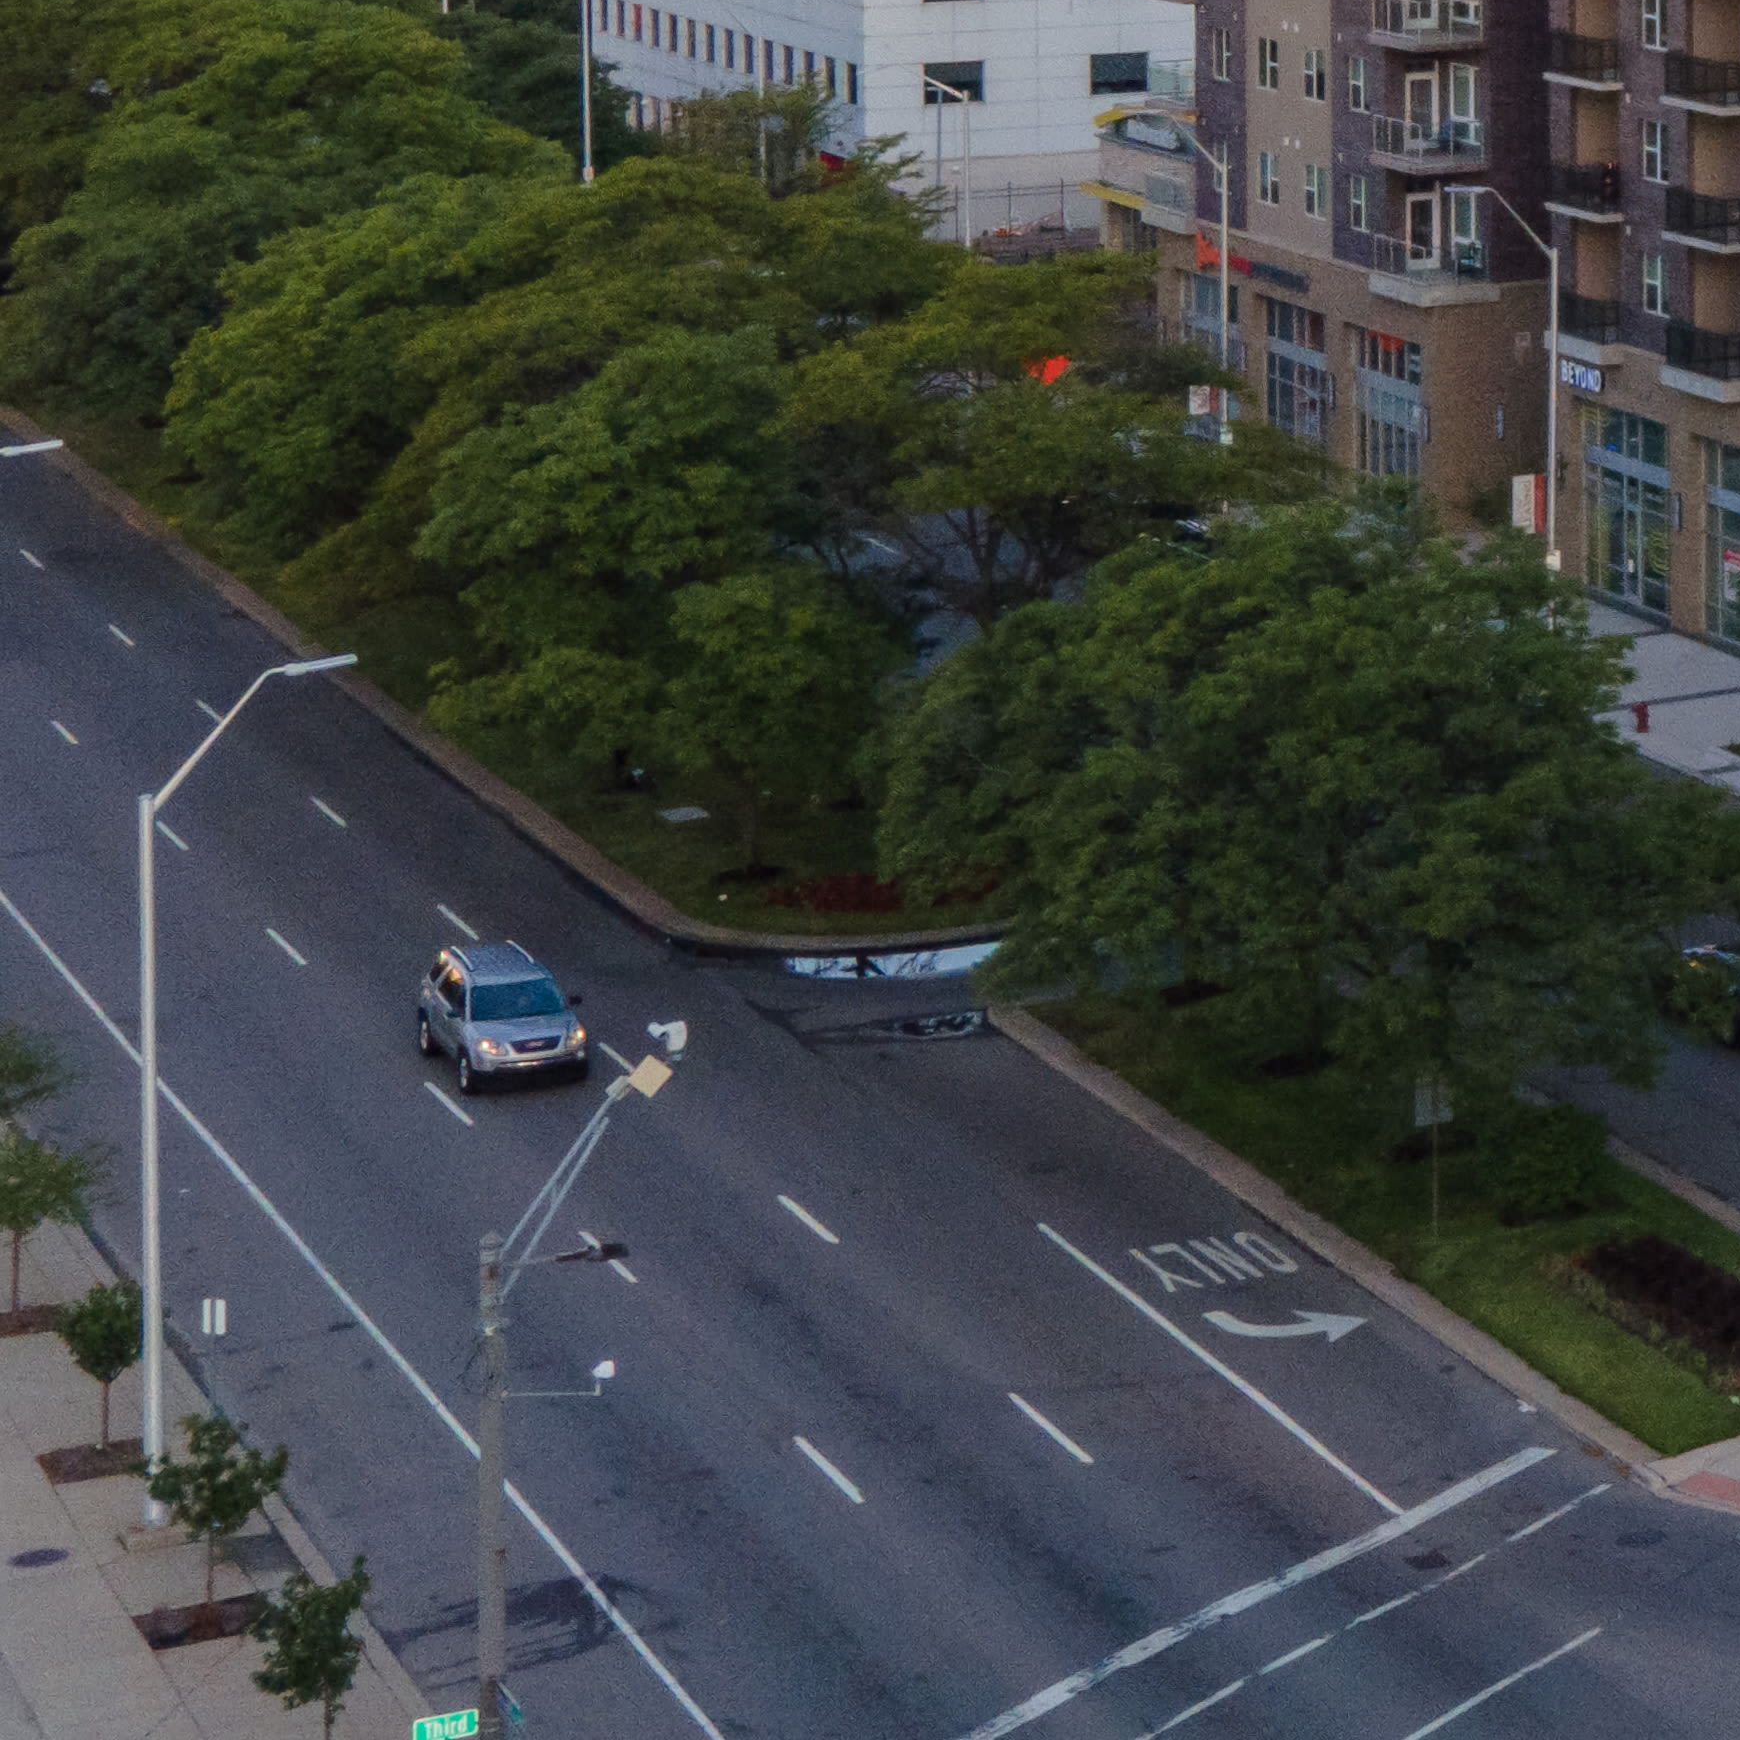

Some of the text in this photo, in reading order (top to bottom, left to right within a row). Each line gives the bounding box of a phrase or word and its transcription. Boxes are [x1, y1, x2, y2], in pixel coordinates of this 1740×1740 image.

[1560, 359, 1602, 393] BEYOND
[1129, 1232, 1299, 1293] ONLY
[426, 1714, 468, 1740] Third
